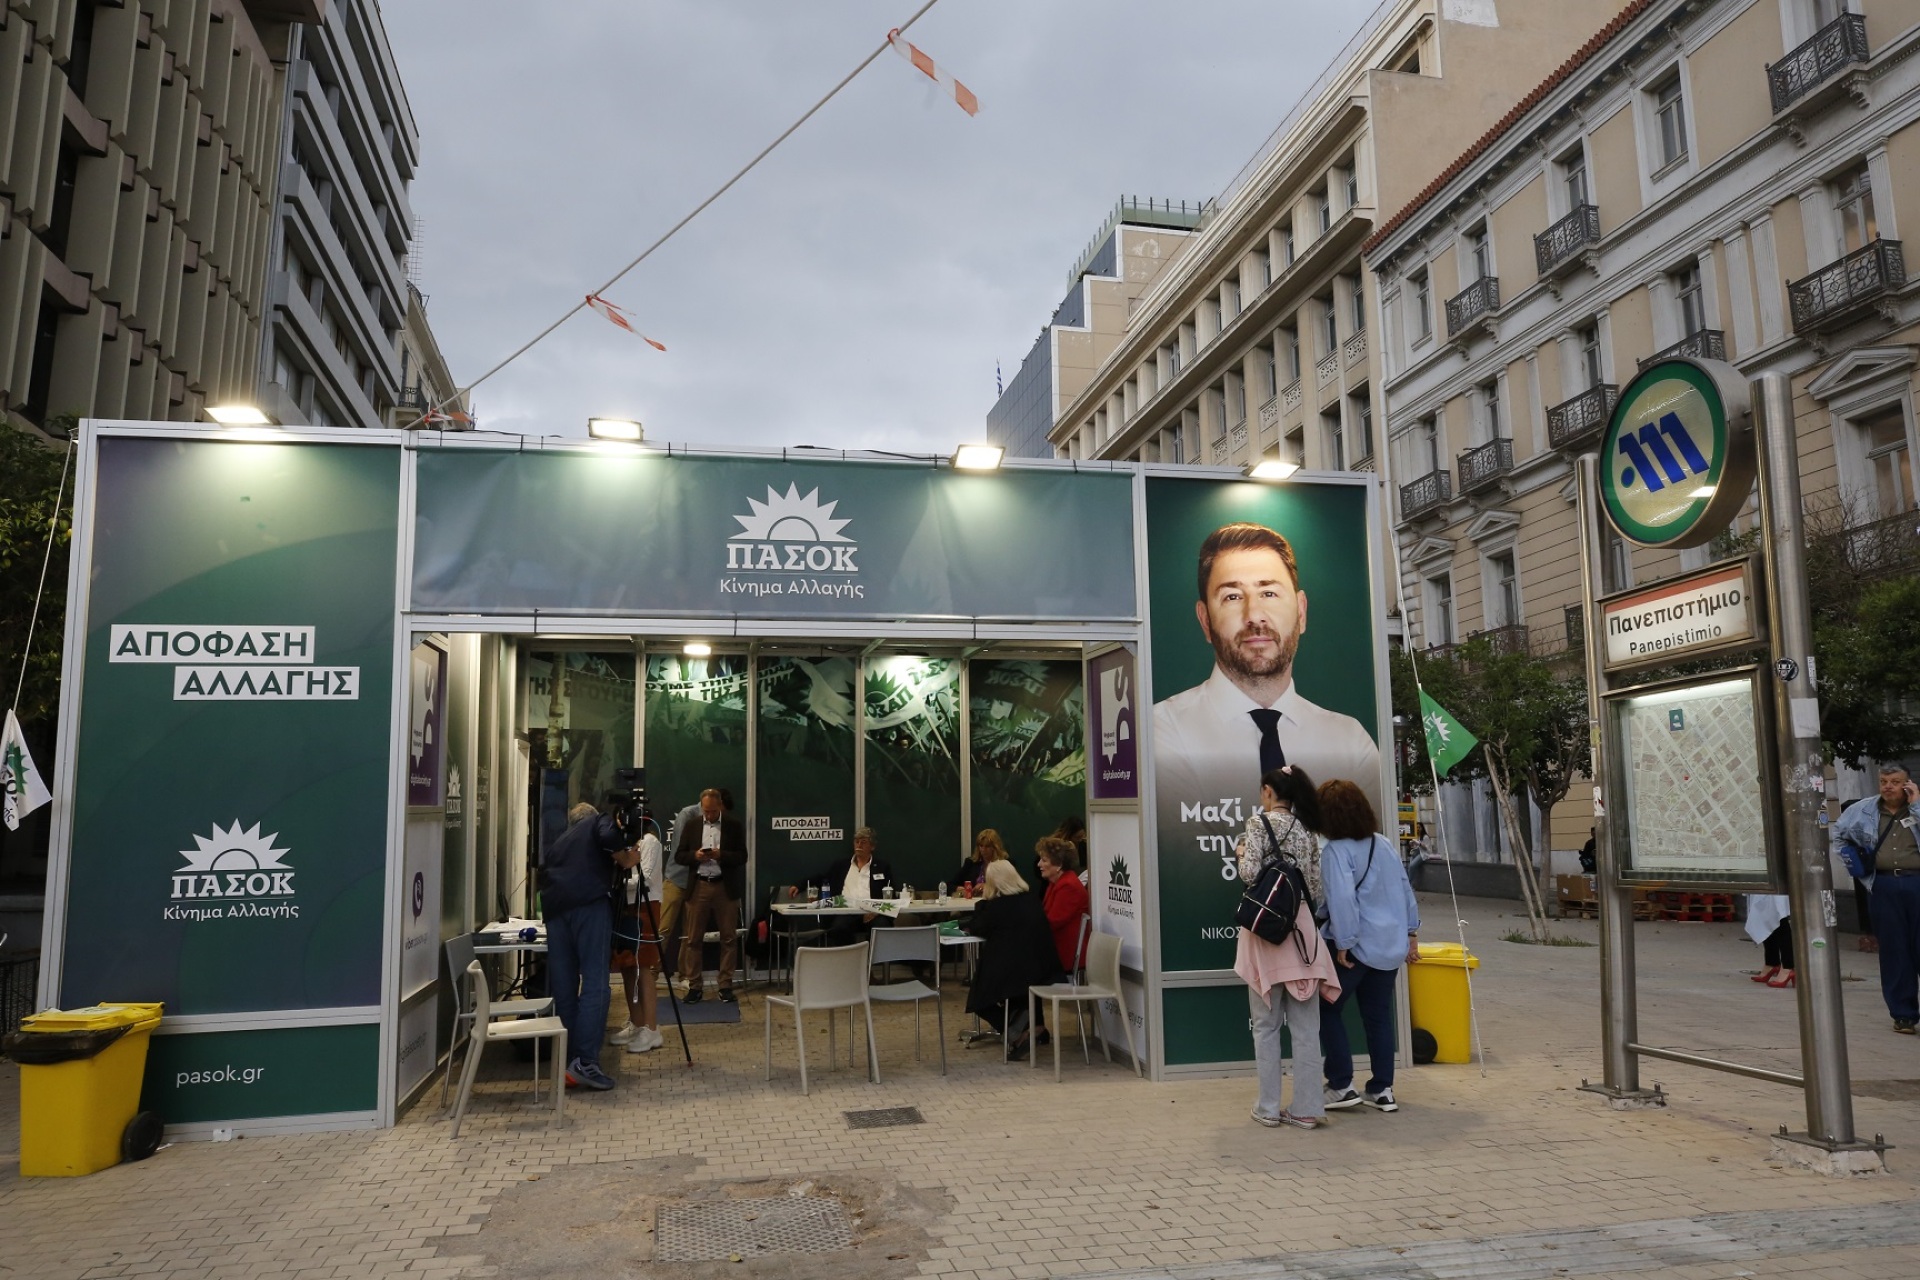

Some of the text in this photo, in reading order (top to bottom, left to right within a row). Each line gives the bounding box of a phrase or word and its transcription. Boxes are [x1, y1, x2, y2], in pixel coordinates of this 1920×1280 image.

[726, 543, 859, 572] ΠΑΣΟΚ
[720, 577, 864, 599] Κίνημα Αλλαγής
[1609, 586, 1741, 637] Πανεπιστήμιο
[115, 629, 308, 658] ΑΠΟΦΑΣΗ
[1629, 623, 1723, 656] Panepistimio
[179, 668, 353, 697] ΑΛΛΑΓΗΣ
[773, 817, 828, 829] ΑΠΟΦΑΣΗ
[1180, 797, 1244, 828] Μαζί
[792, 829, 842, 840] ΑΛΛΑΓΗΣ
[170, 872, 296, 900] ΠΑΣΟΚ
[1108, 886, 1133, 905] ΠΑΣΟΚ
[163, 901, 300, 922] Κίνημα Αλλαγής
[176, 1063, 265, 1089] pasok.gr
